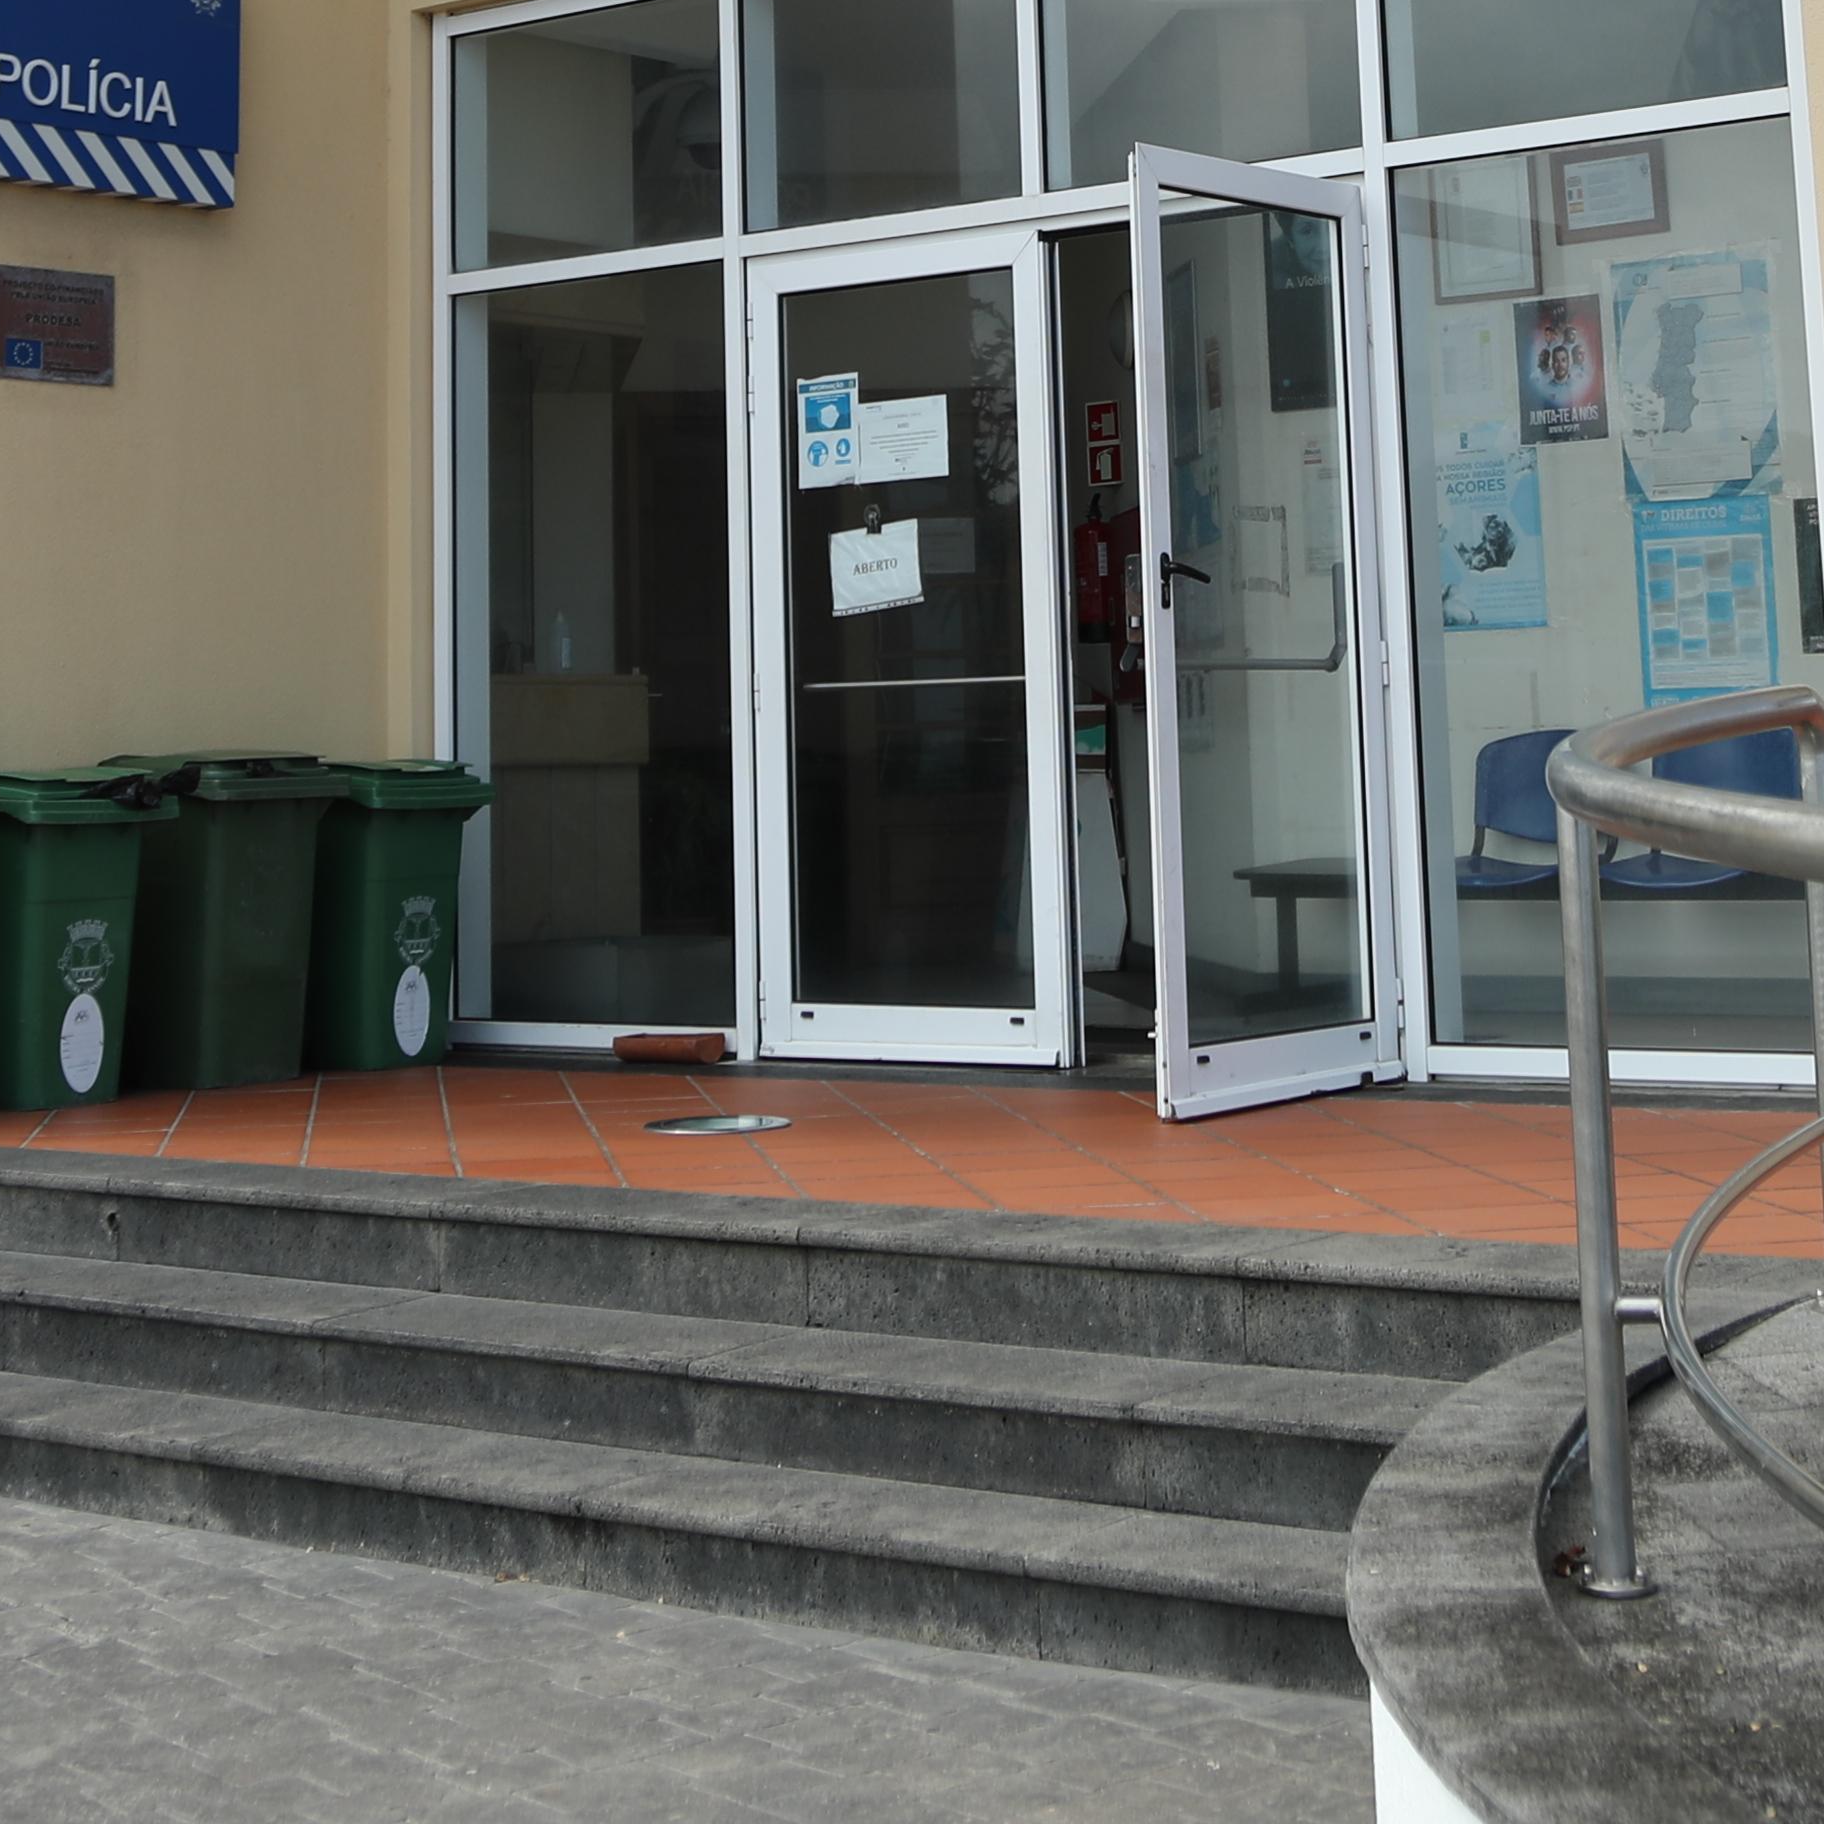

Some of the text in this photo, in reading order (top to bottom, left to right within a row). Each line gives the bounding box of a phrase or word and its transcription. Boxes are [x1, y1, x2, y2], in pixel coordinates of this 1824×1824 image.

[25, 313, 81, 328] PRODESA
[1529, 408, 1570, 426] JUNTA-TE
[1579, 401, 1600, 422] NÓS
[1446, 478, 1506, 496] AÇORES
[1661, 504, 1727, 522] DIREITOS
[853, 558, 898, 576] ABERTO
